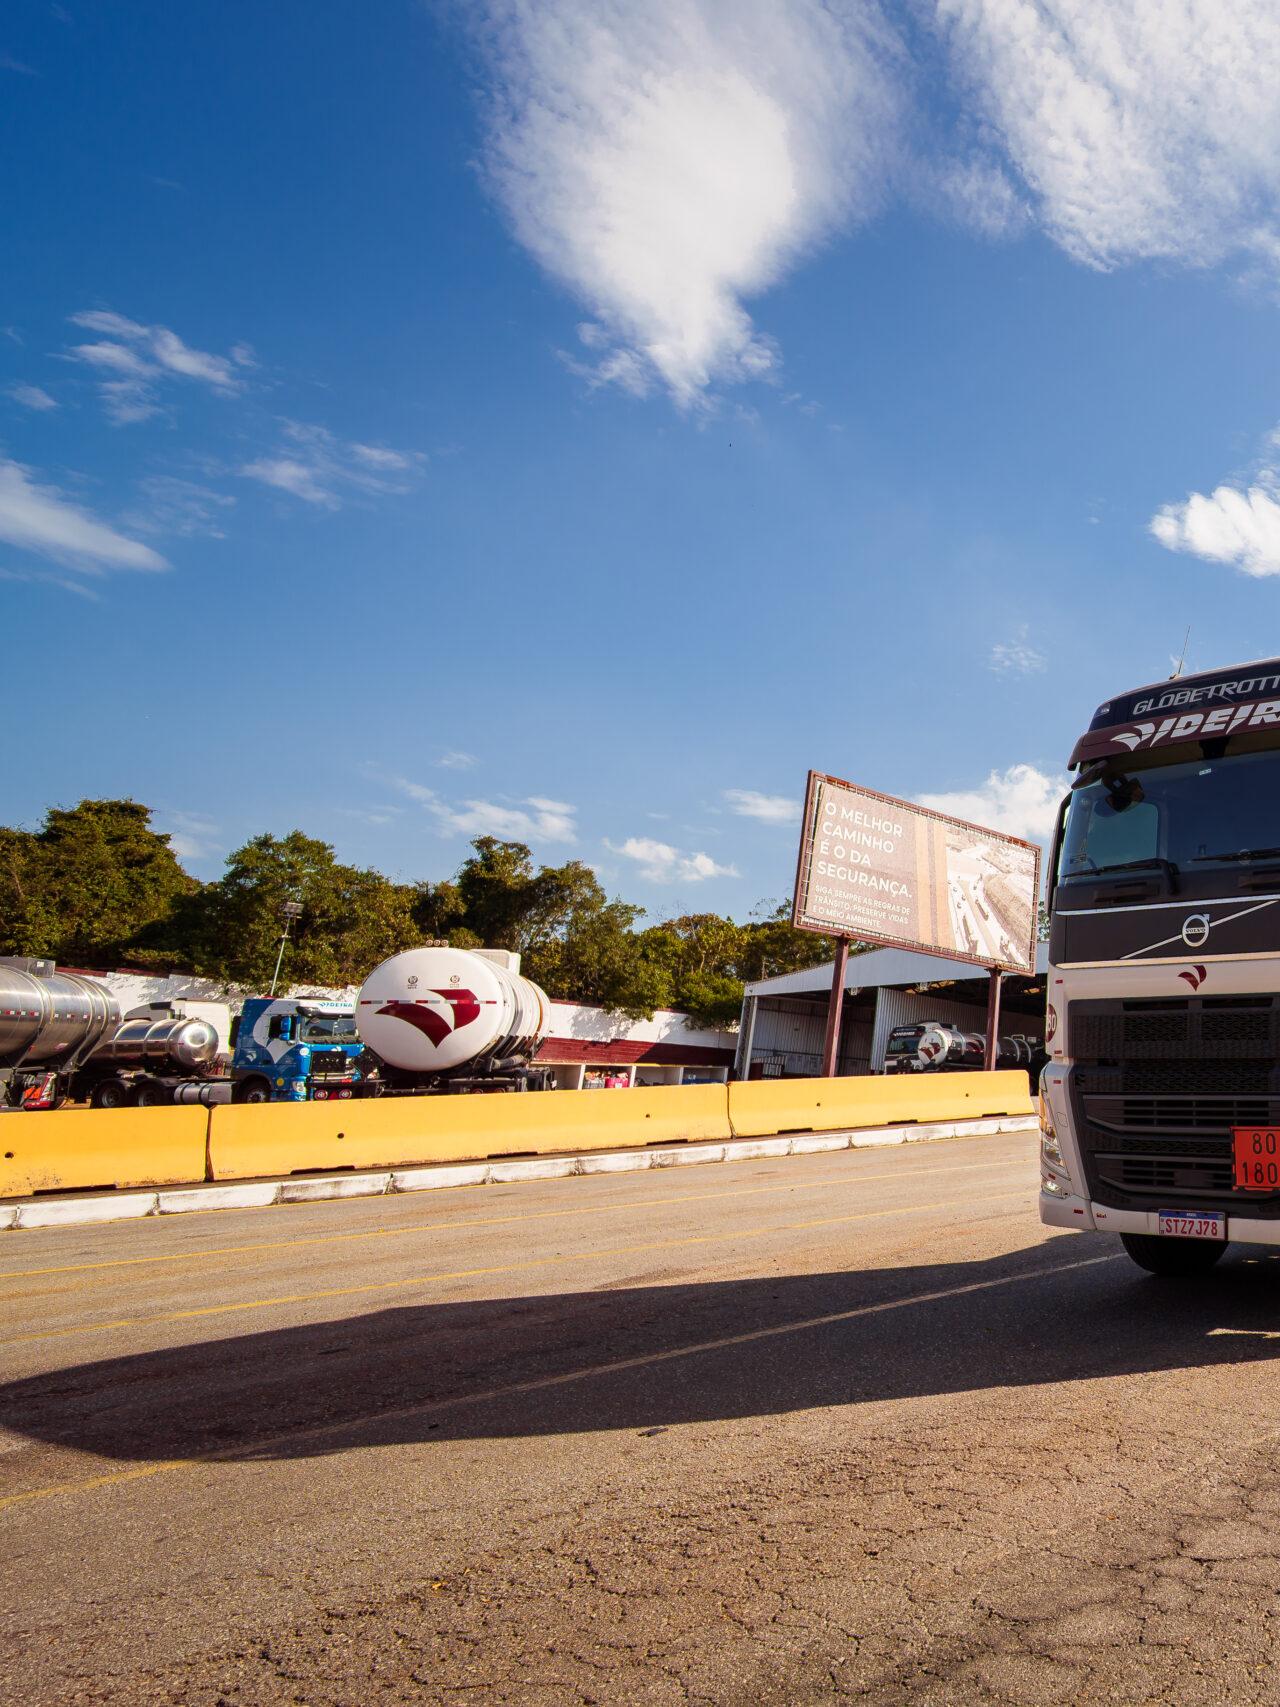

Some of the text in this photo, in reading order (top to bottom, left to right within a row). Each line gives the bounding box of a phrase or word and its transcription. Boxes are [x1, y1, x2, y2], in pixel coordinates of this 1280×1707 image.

[825, 802, 903, 837] O MELHOR
[822, 822, 894, 853] CAMINHO
[820, 839, 872, 867] É O DA
[817, 861, 912, 898] SEGURANÇA.
[815, 884, 911, 915] SIGA SEMPRE AS REGRAS DE
[818, 906, 825, 915] O
[826, 908, 845, 919] MEIO
[853, 904, 887, 919] PRESERVE
[888, 912, 909, 925] VIDAS
[1252, 1132, 1277, 1155] 80
[1165, 1218, 1218, 1237] STZ7J78
